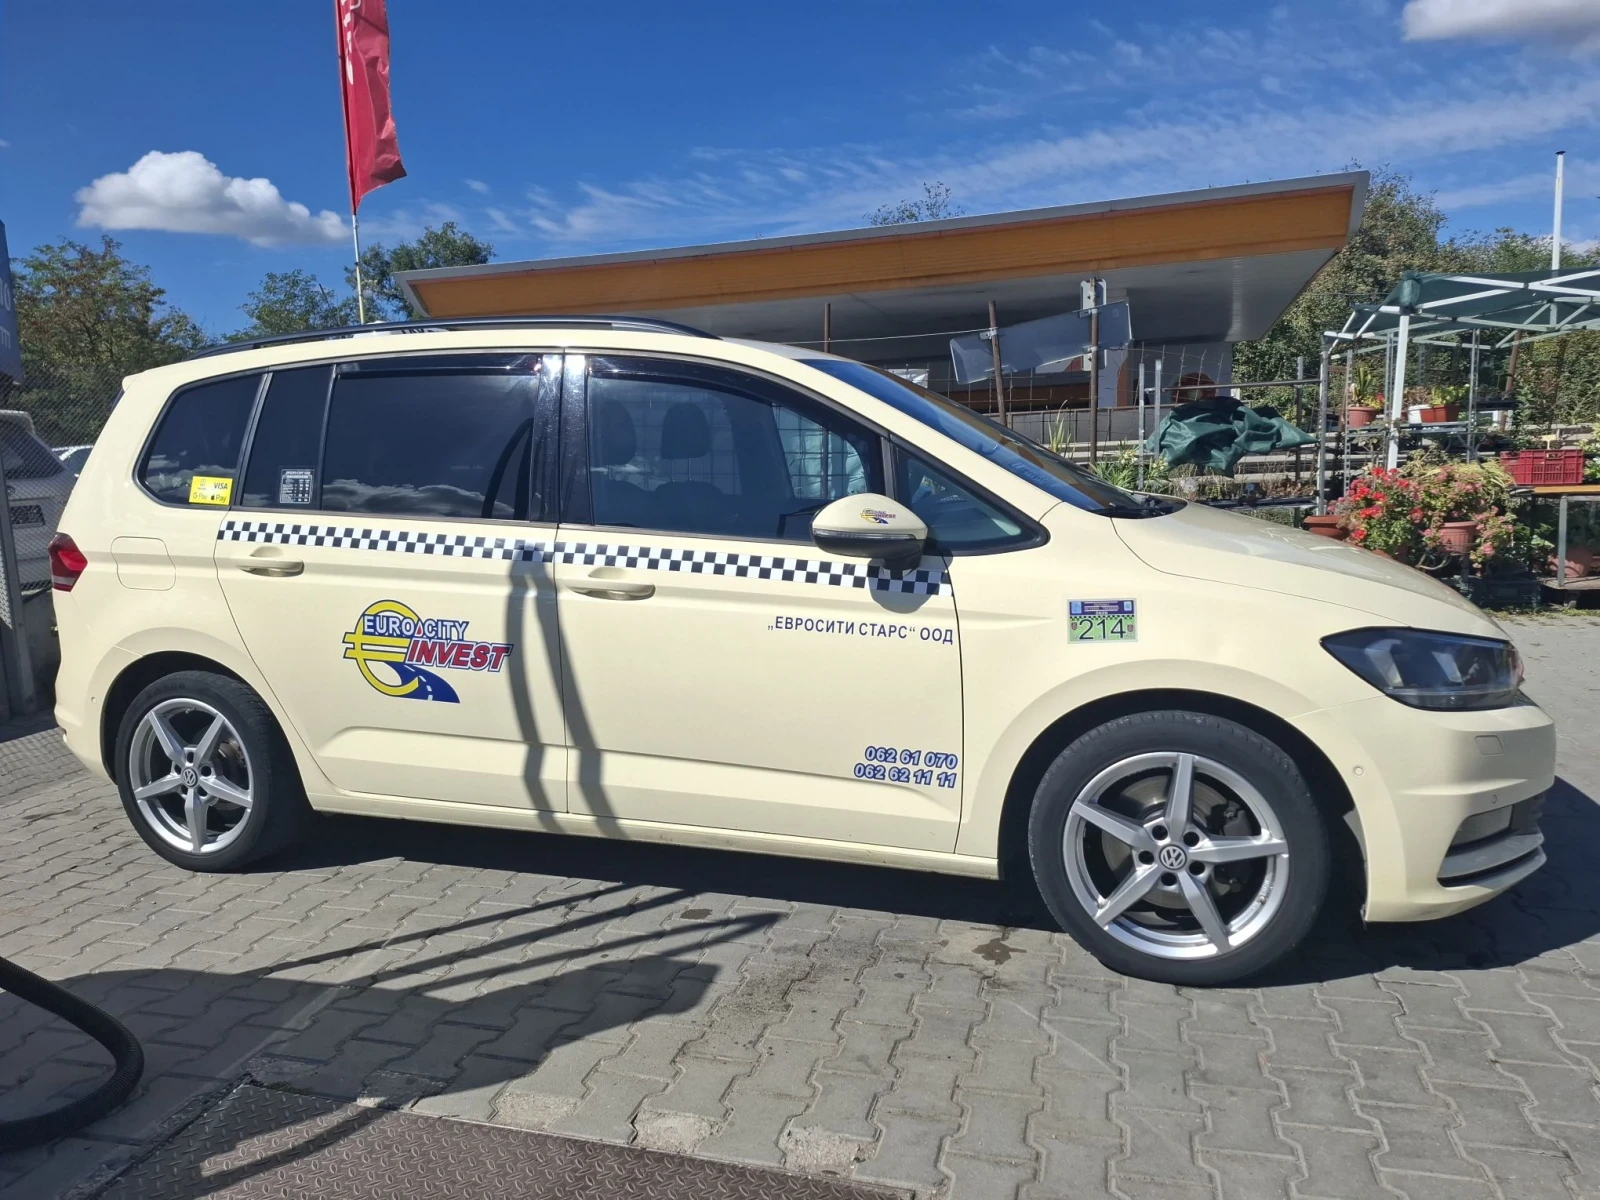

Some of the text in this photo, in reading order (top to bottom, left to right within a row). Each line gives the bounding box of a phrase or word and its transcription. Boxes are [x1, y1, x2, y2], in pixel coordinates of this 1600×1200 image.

[213, 482, 228, 490] VISA
[215, 494, 227, 503] Pay
[768, 616, 954, 645] „ЕВРОСИТИ СТАРС“ ООД
[1079, 618, 1126, 640] 214
[405, 637, 513, 672] INVEST
[865, 745, 959, 770] 062 61 070
[853, 762, 957, 789] 062 62 11 11
